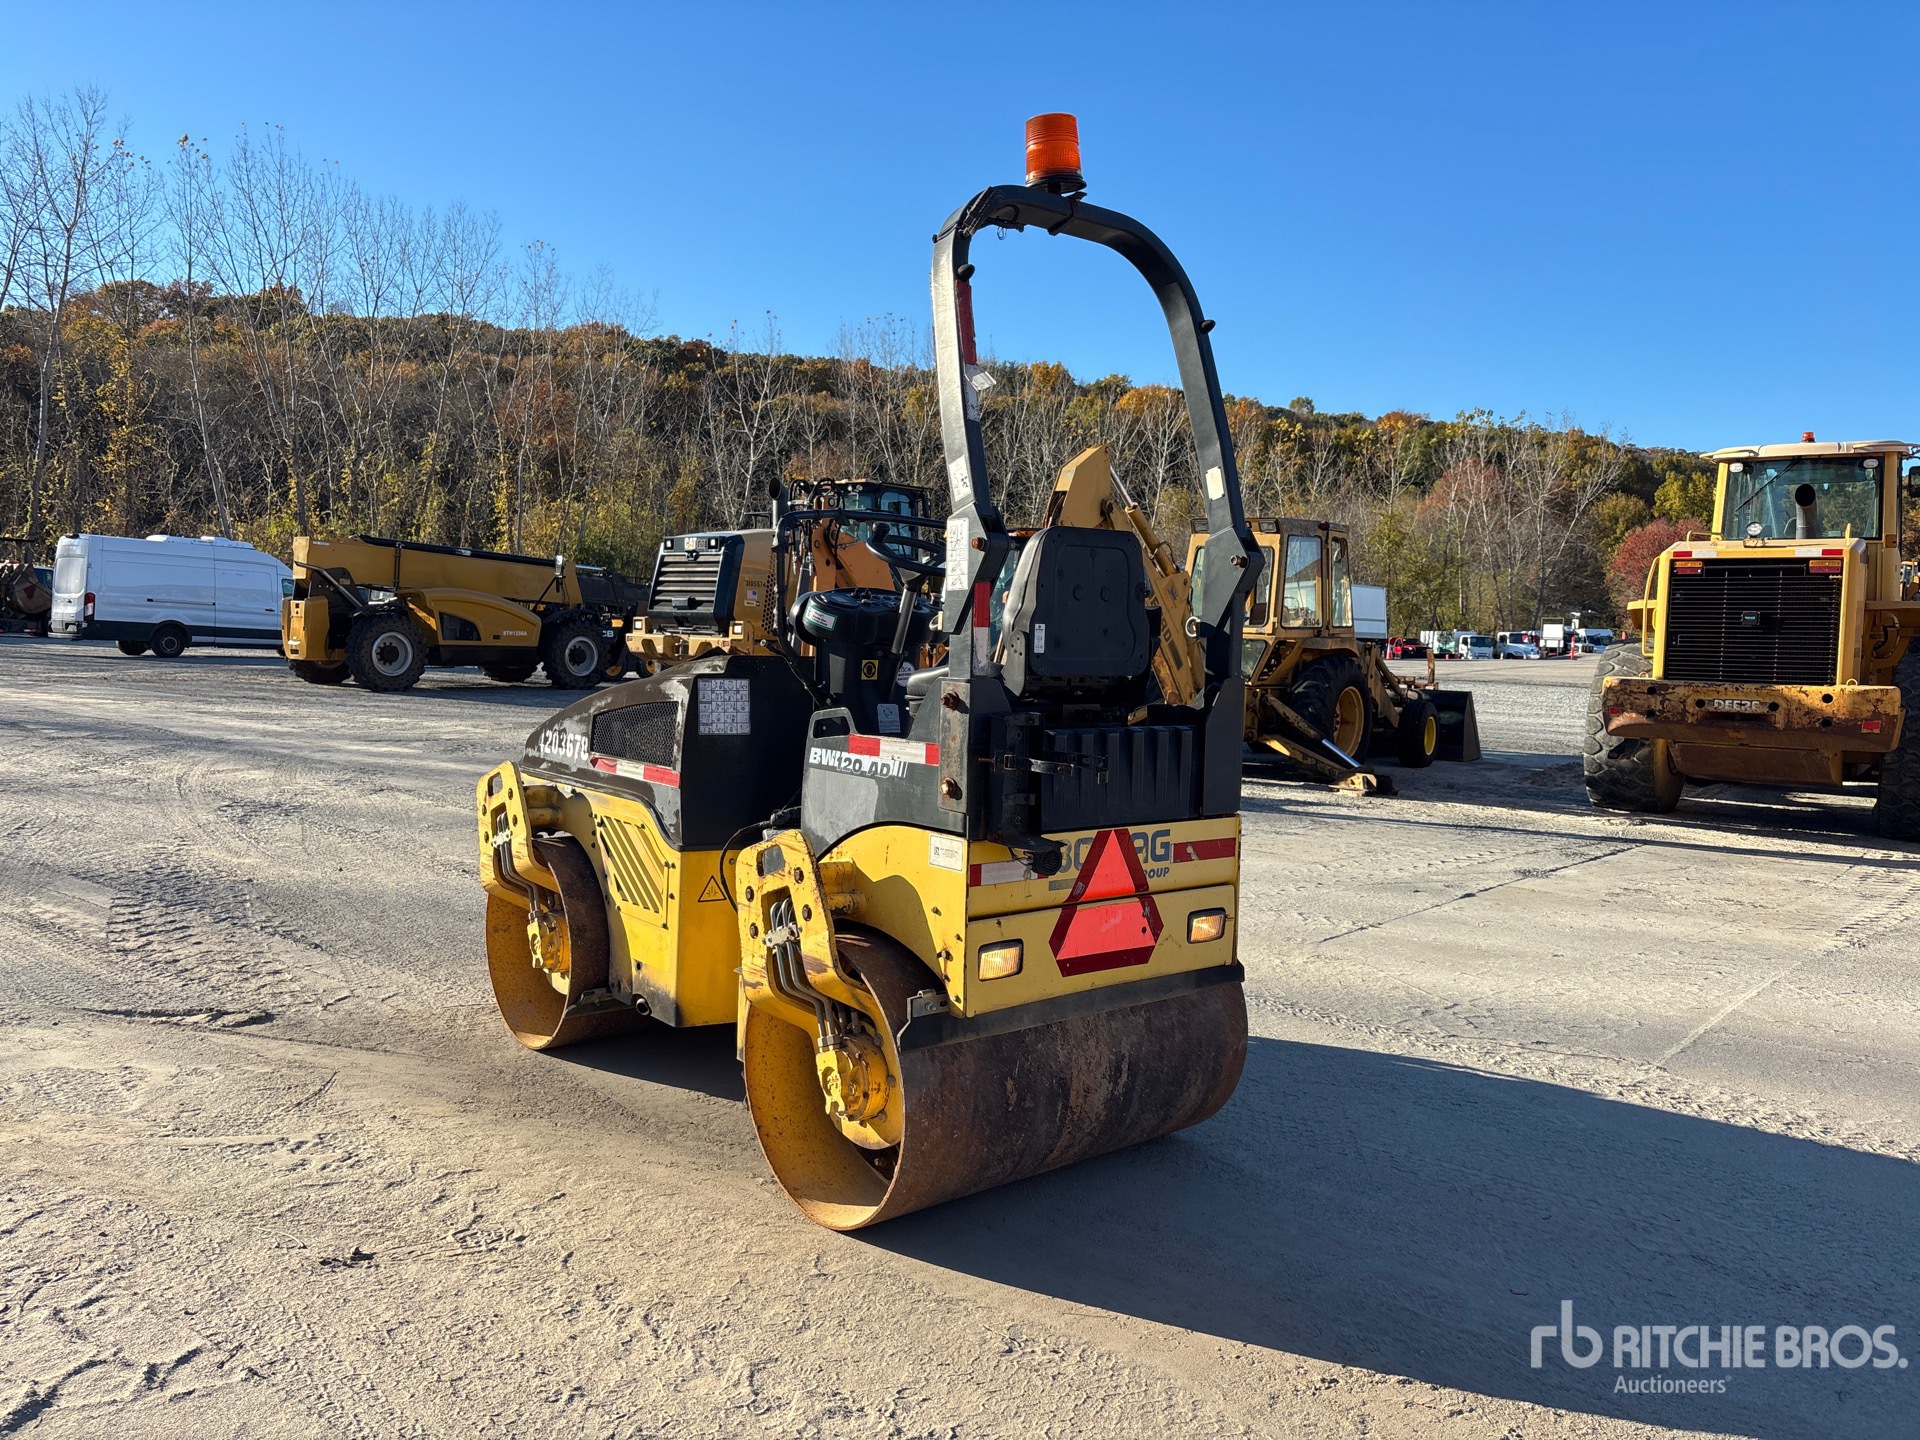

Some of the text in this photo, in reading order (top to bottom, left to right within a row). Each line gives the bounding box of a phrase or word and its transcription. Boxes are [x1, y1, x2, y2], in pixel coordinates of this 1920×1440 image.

[684, 537, 698, 550] CAT
[602, 630, 614, 638] CB
[1057, 829, 1171, 873] BOAG
